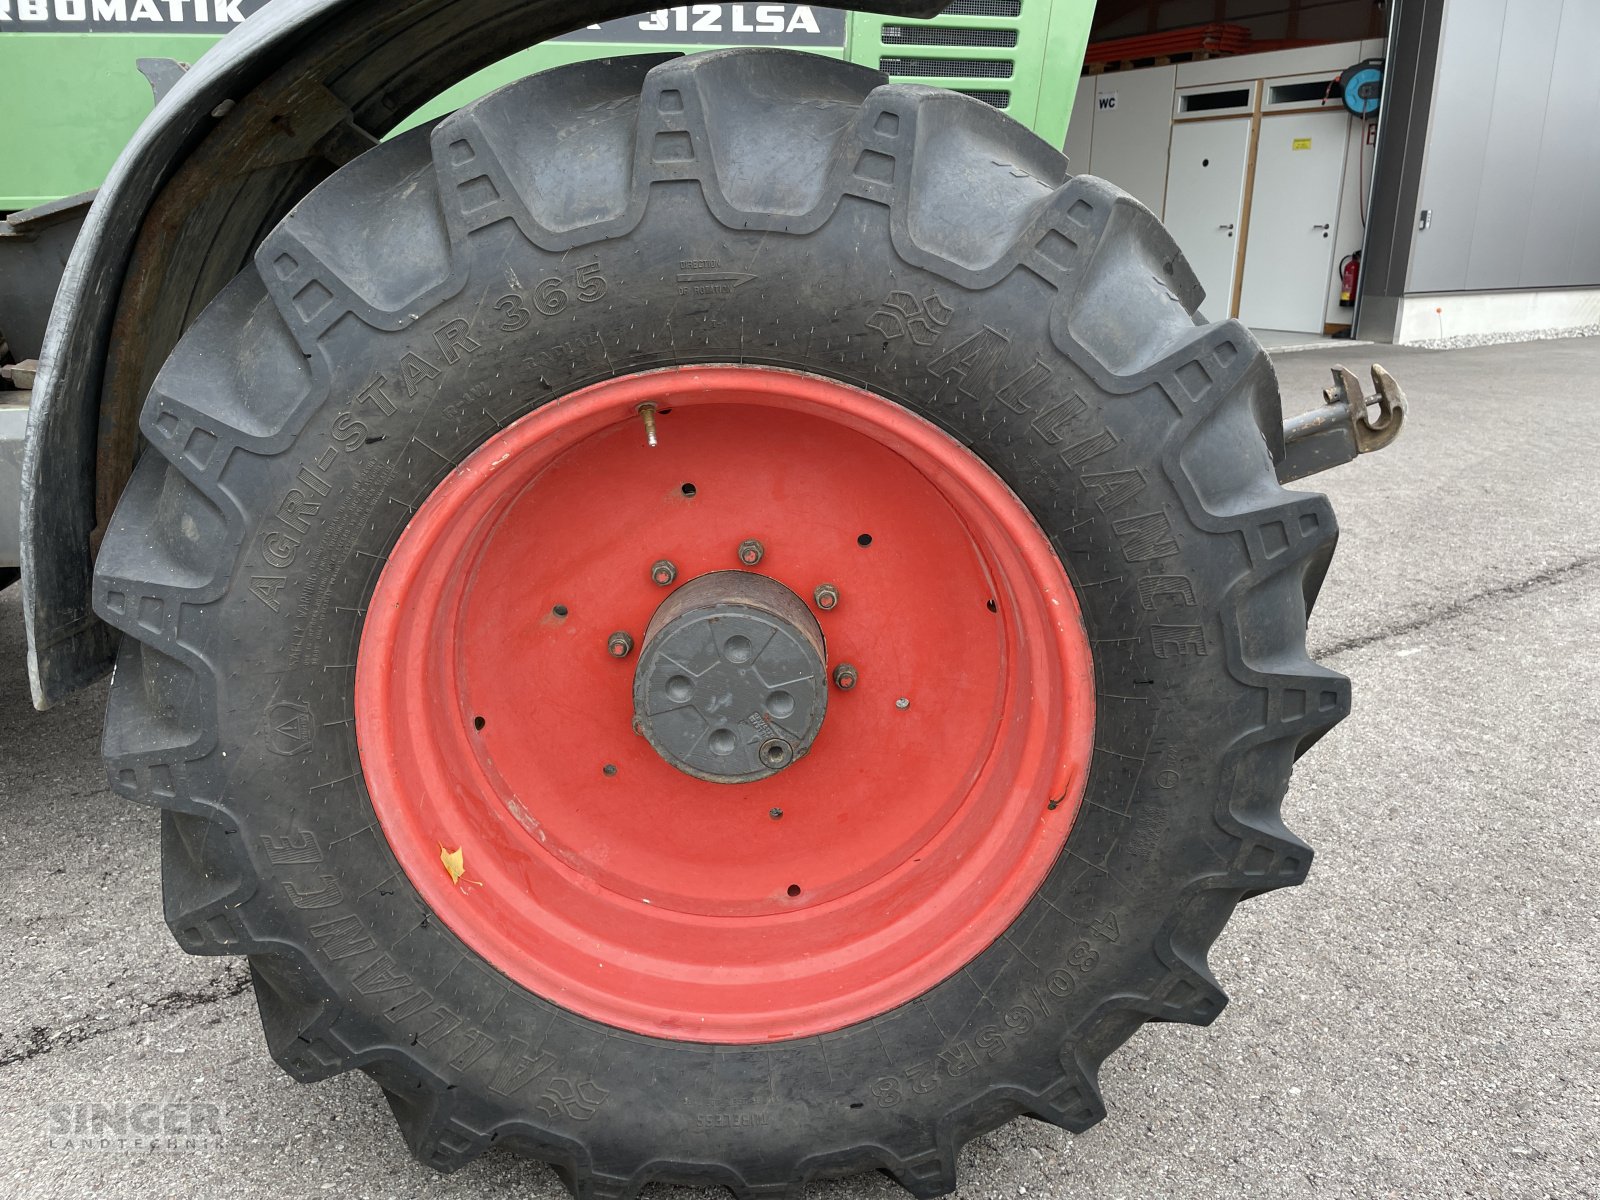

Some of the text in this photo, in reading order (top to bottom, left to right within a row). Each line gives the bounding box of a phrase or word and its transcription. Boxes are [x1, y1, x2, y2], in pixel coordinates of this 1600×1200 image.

[638, 4, 821, 35] 312 LSA
[1099, 97, 1116, 110] WC
[248, 317, 482, 612] AGRI-STAR
[494, 262, 608, 332] 365
[926, 324, 1209, 659] ALLIANCE
[259, 830, 557, 1096] ALLIANCE
[870, 911, 1121, 1110] 480/65R28
[696, 1112, 769, 1128] TUBELESS
